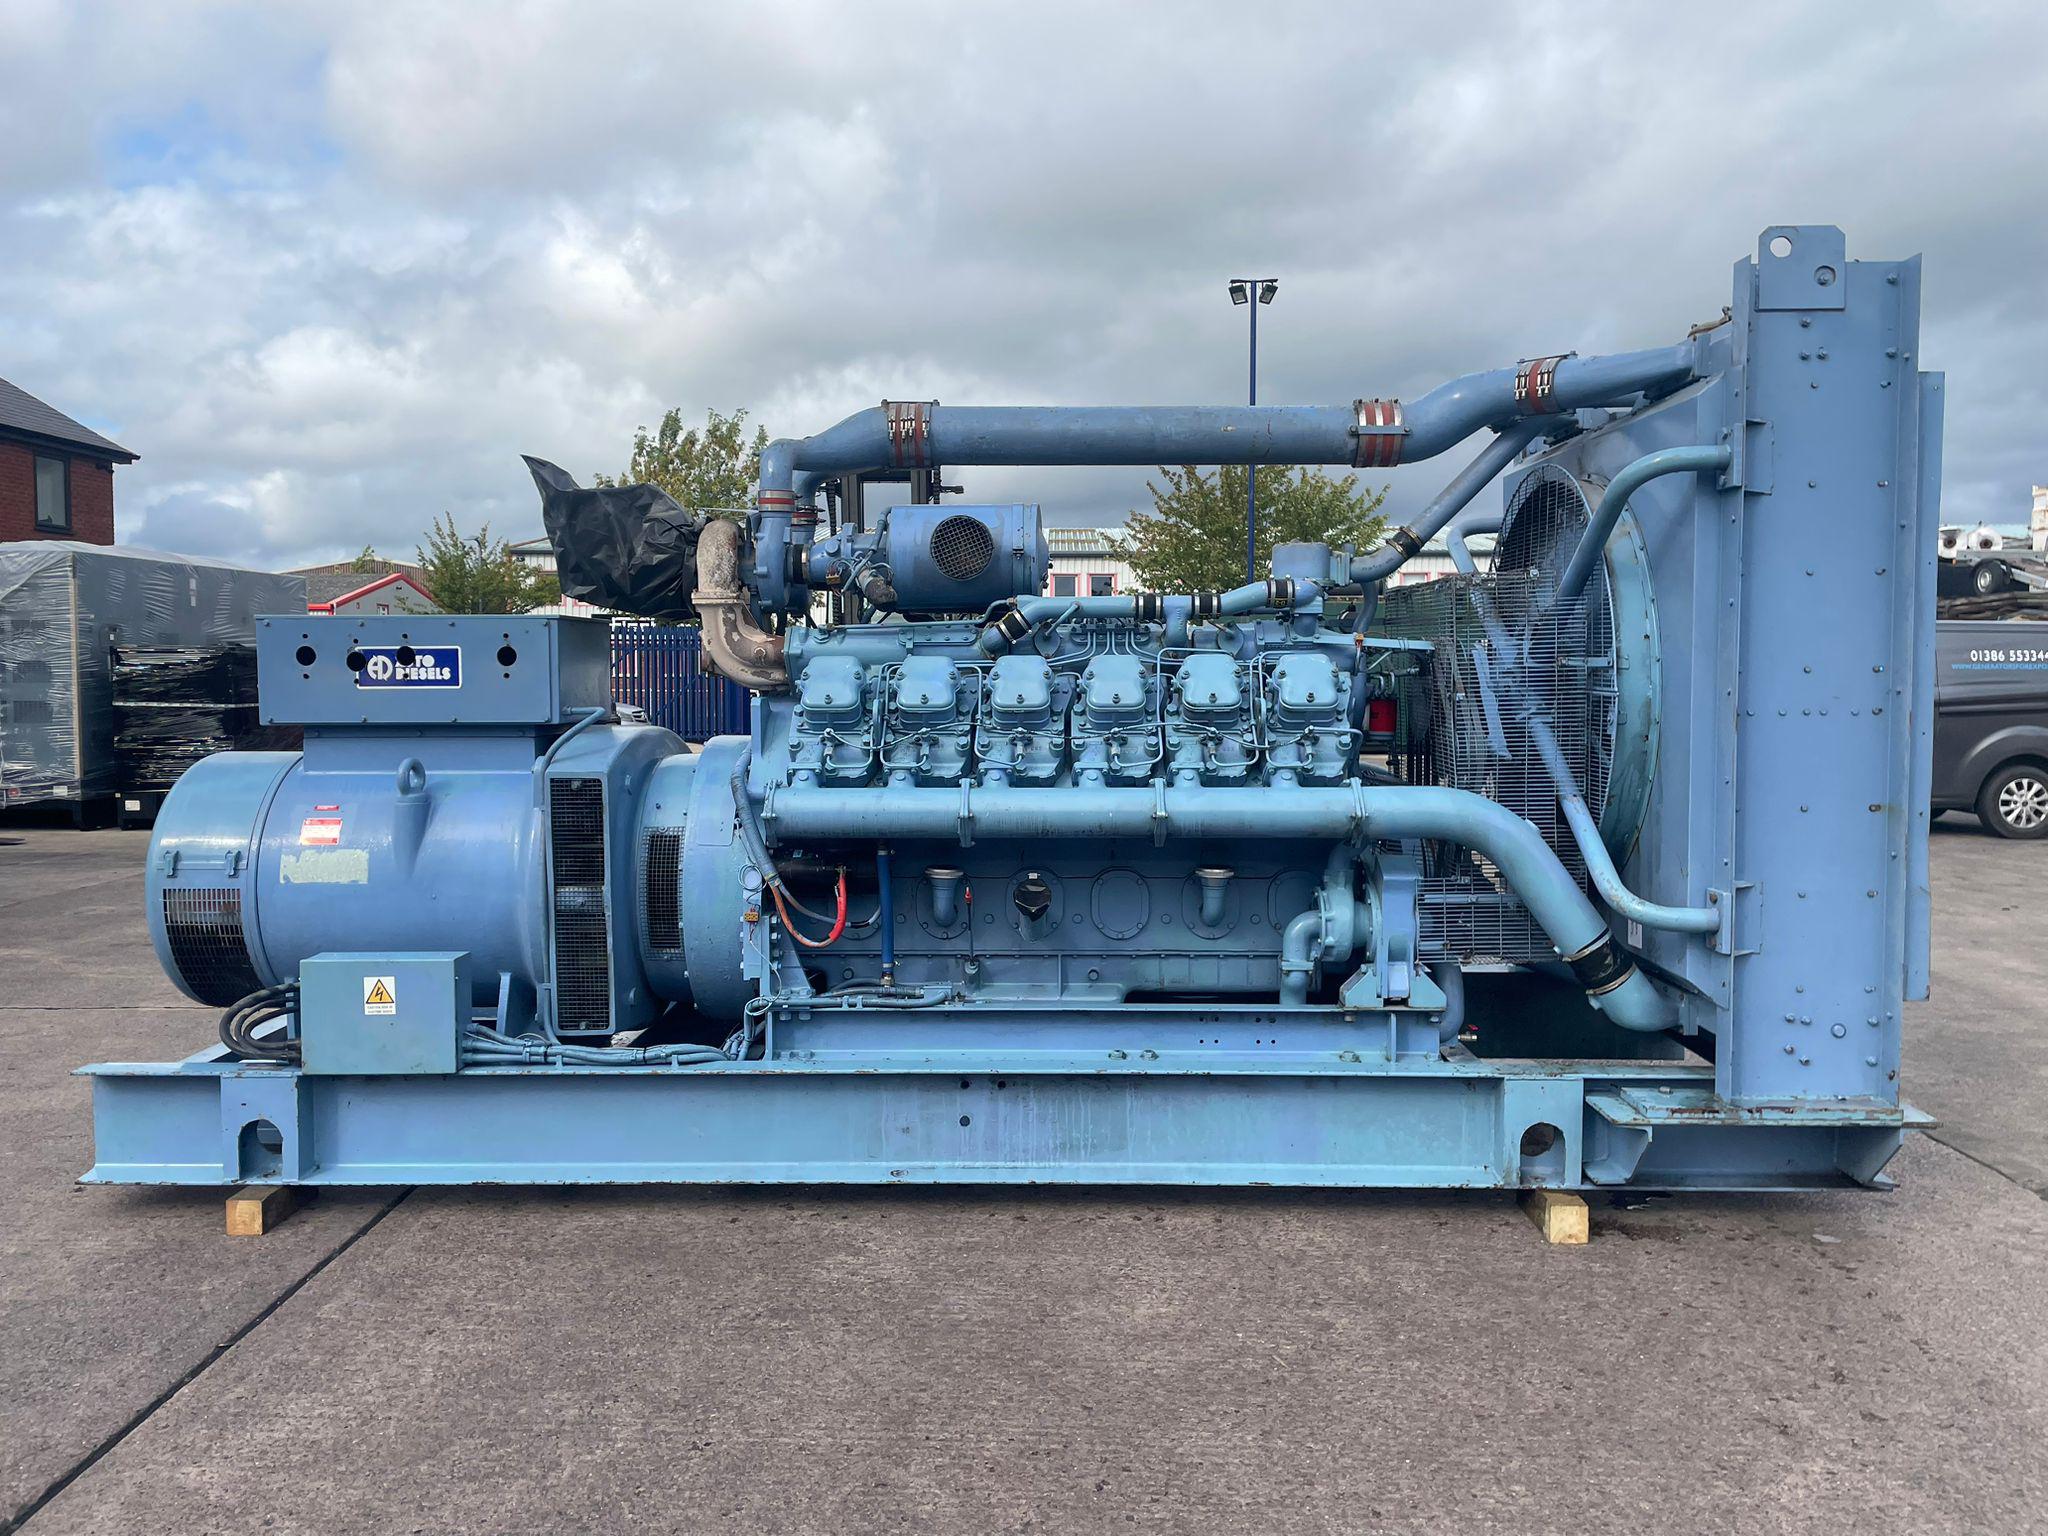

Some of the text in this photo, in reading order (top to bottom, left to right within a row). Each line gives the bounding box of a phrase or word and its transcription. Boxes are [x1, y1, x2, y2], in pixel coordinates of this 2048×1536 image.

[395, 655, 435, 668] TO
[1970, 649, 2006, 662] 01386
[395, 667, 451, 680] DIESELS
